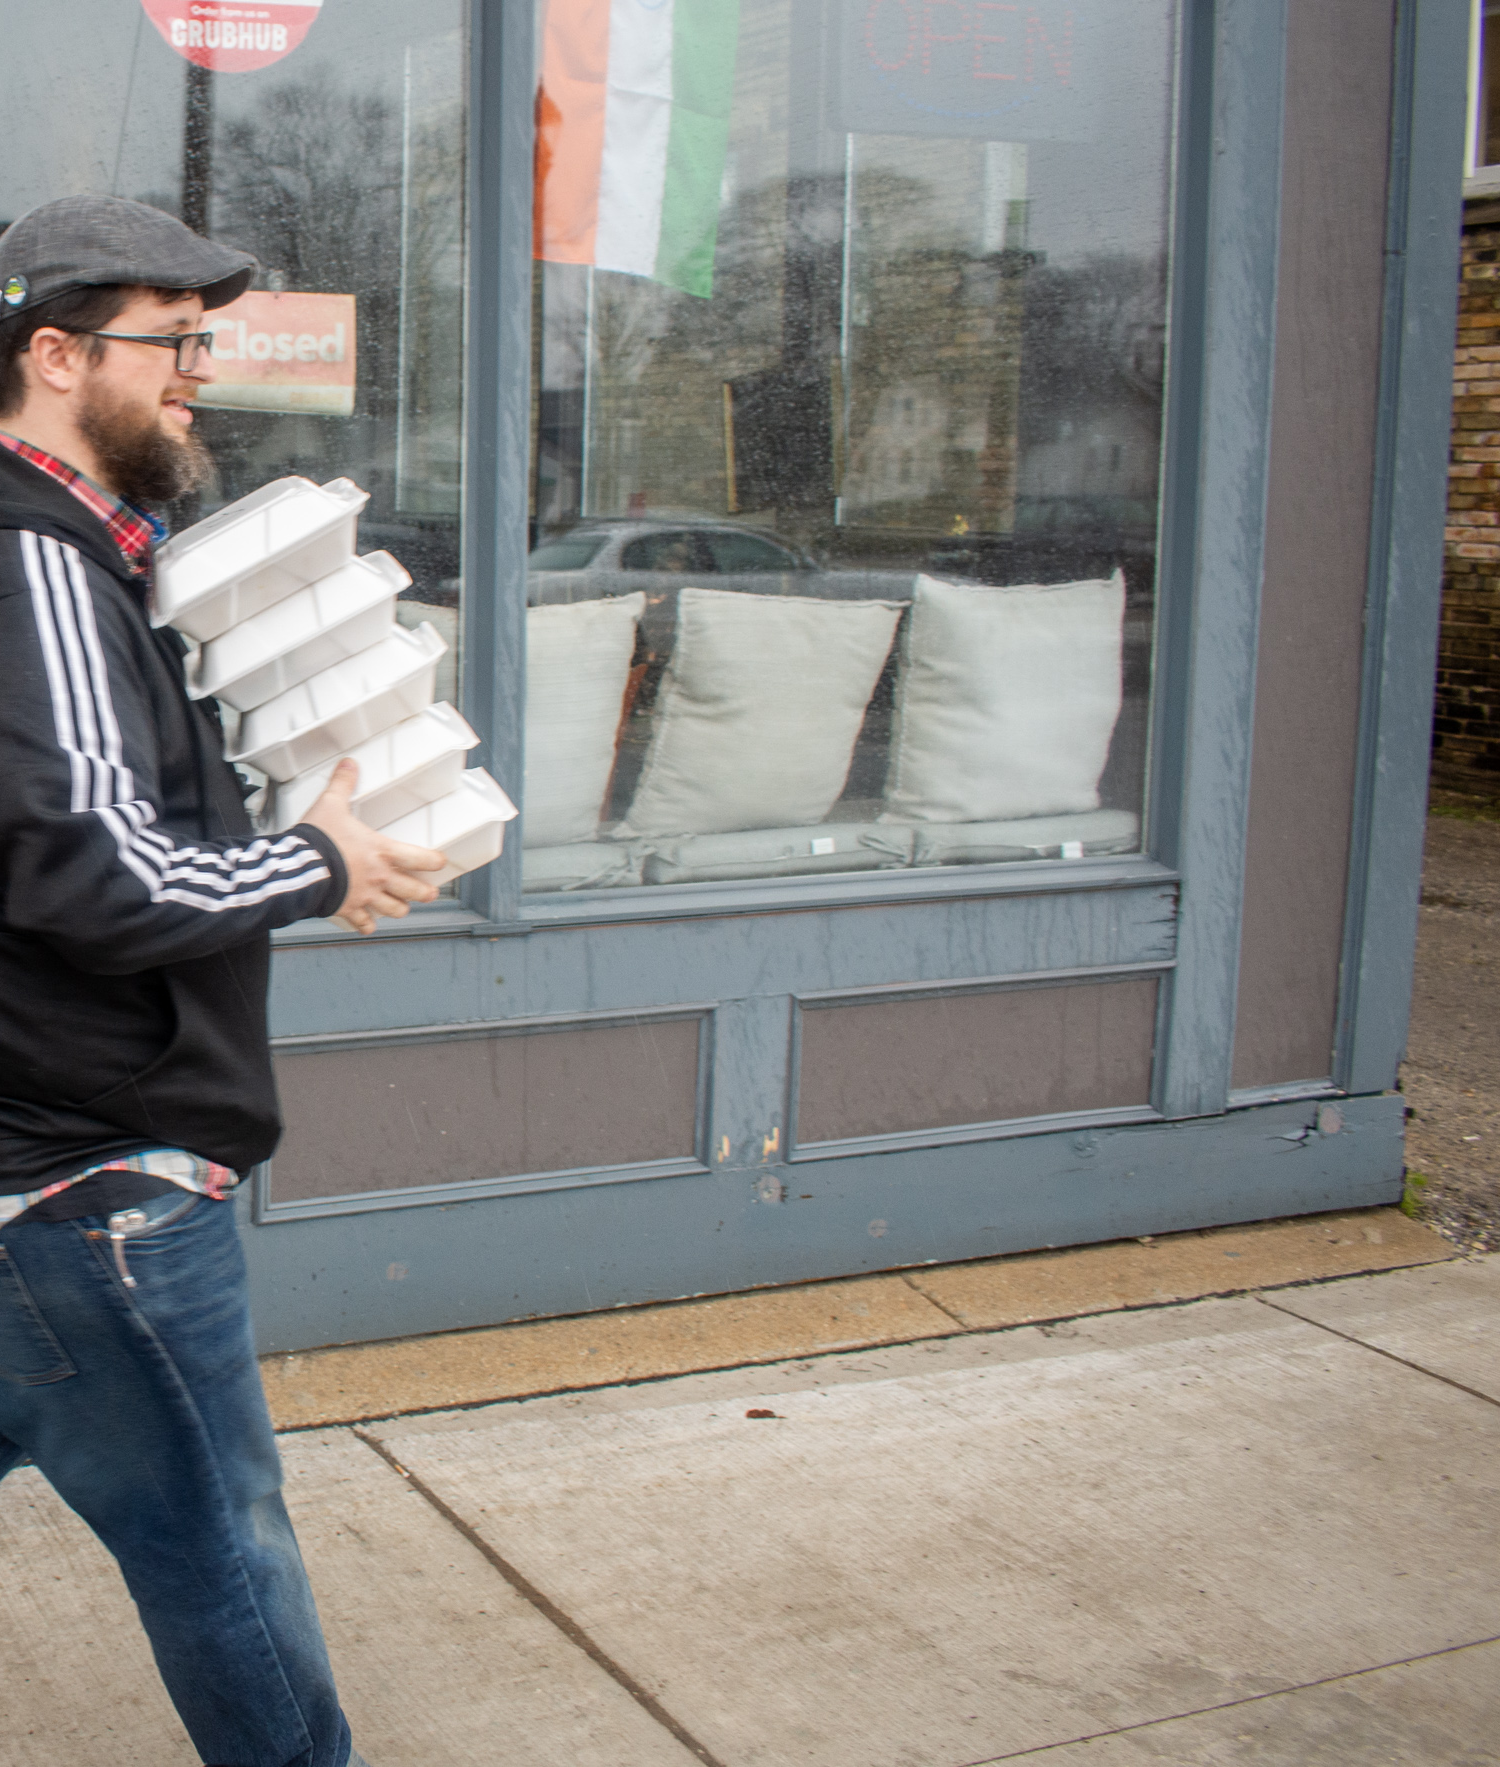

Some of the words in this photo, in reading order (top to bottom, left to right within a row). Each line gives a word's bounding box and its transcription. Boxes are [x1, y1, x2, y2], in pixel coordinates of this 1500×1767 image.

[190, 5, 219, 17] Order
[220, 7, 242, 17] from
[170, 18, 288, 52] GRUBHUB
[865, 0, 1073, 85] OPEN
[208, 318, 345, 362] Closed
